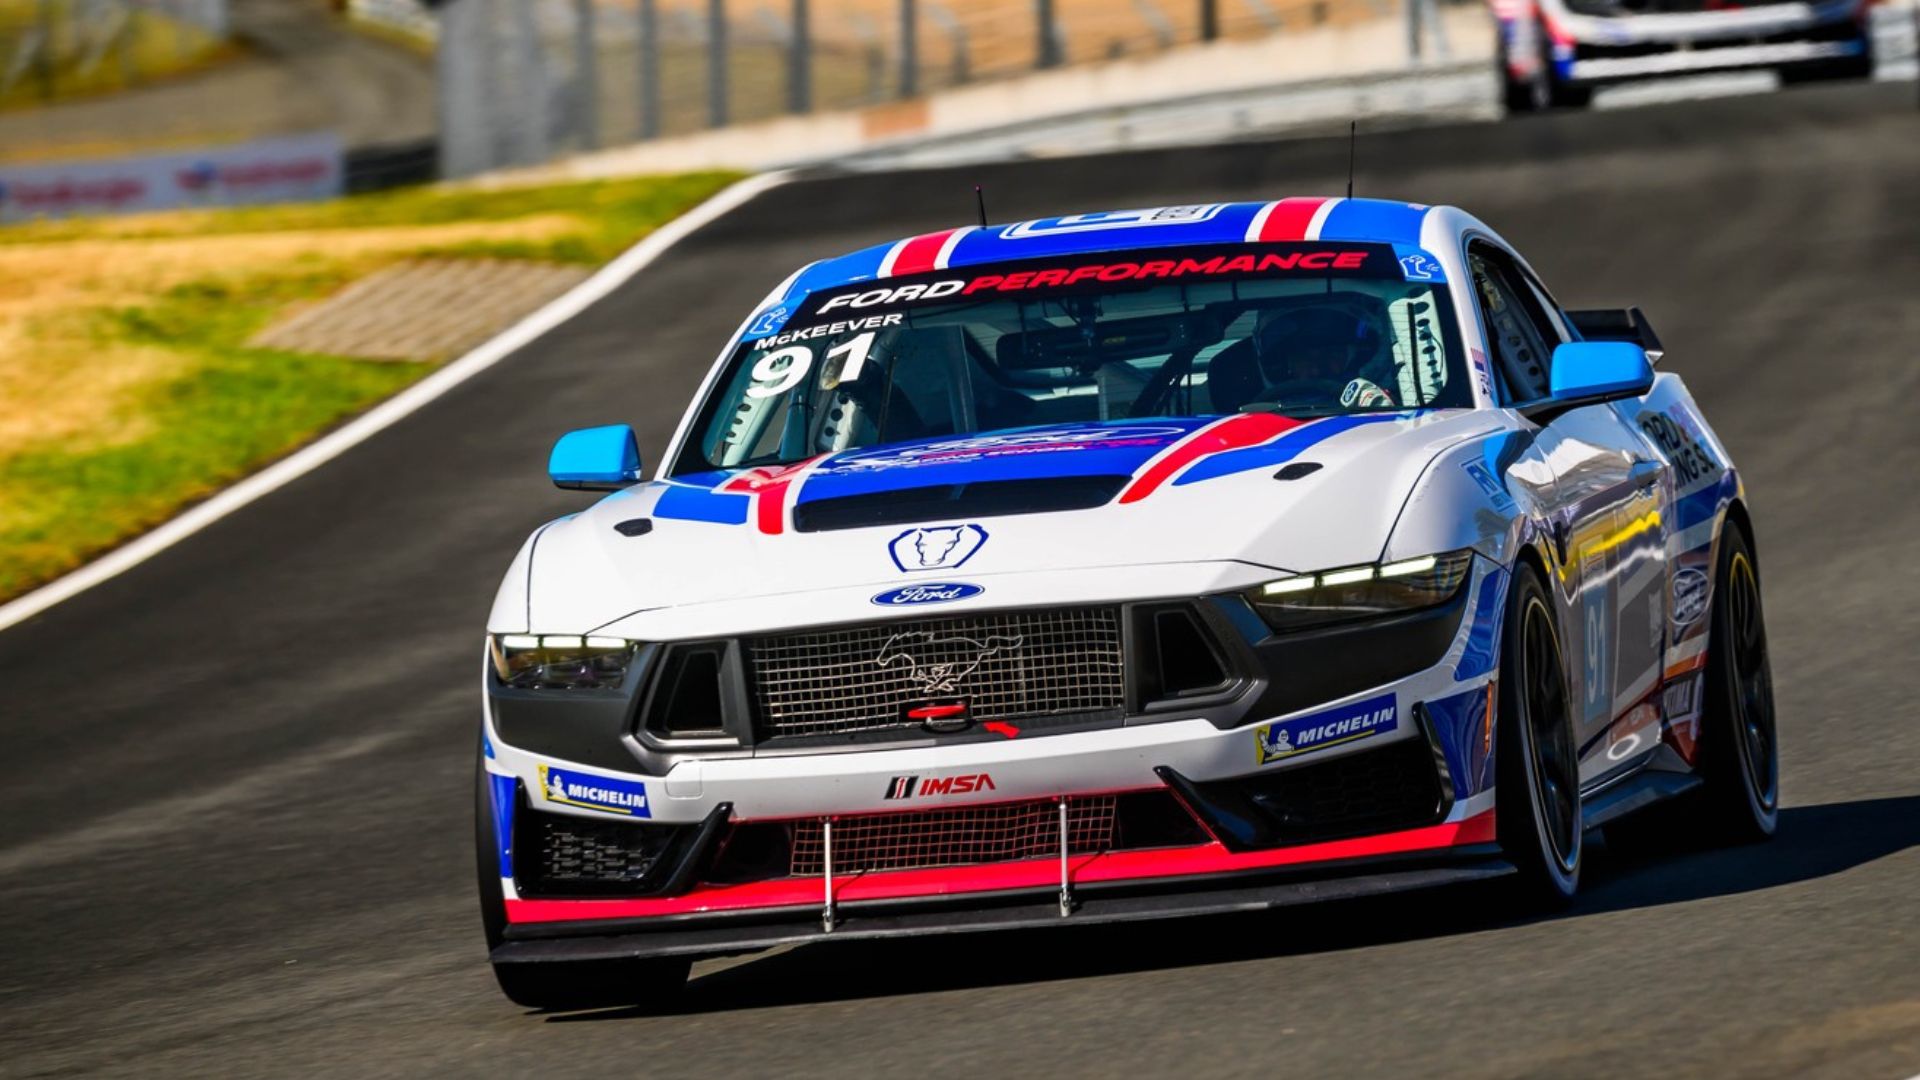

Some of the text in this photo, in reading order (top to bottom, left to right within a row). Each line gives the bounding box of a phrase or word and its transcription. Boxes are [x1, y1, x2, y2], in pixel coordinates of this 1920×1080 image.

[754, 313, 903, 350] McKEEVER
[746, 332, 875, 398] 91
[893, 584, 962, 603] Ford
[1588, 598, 1606, 704] 91
[1297, 707, 1395, 745] MICHELIN
[568, 784, 645, 808] MICHELIN
[919, 774, 996, 796] IMSA
